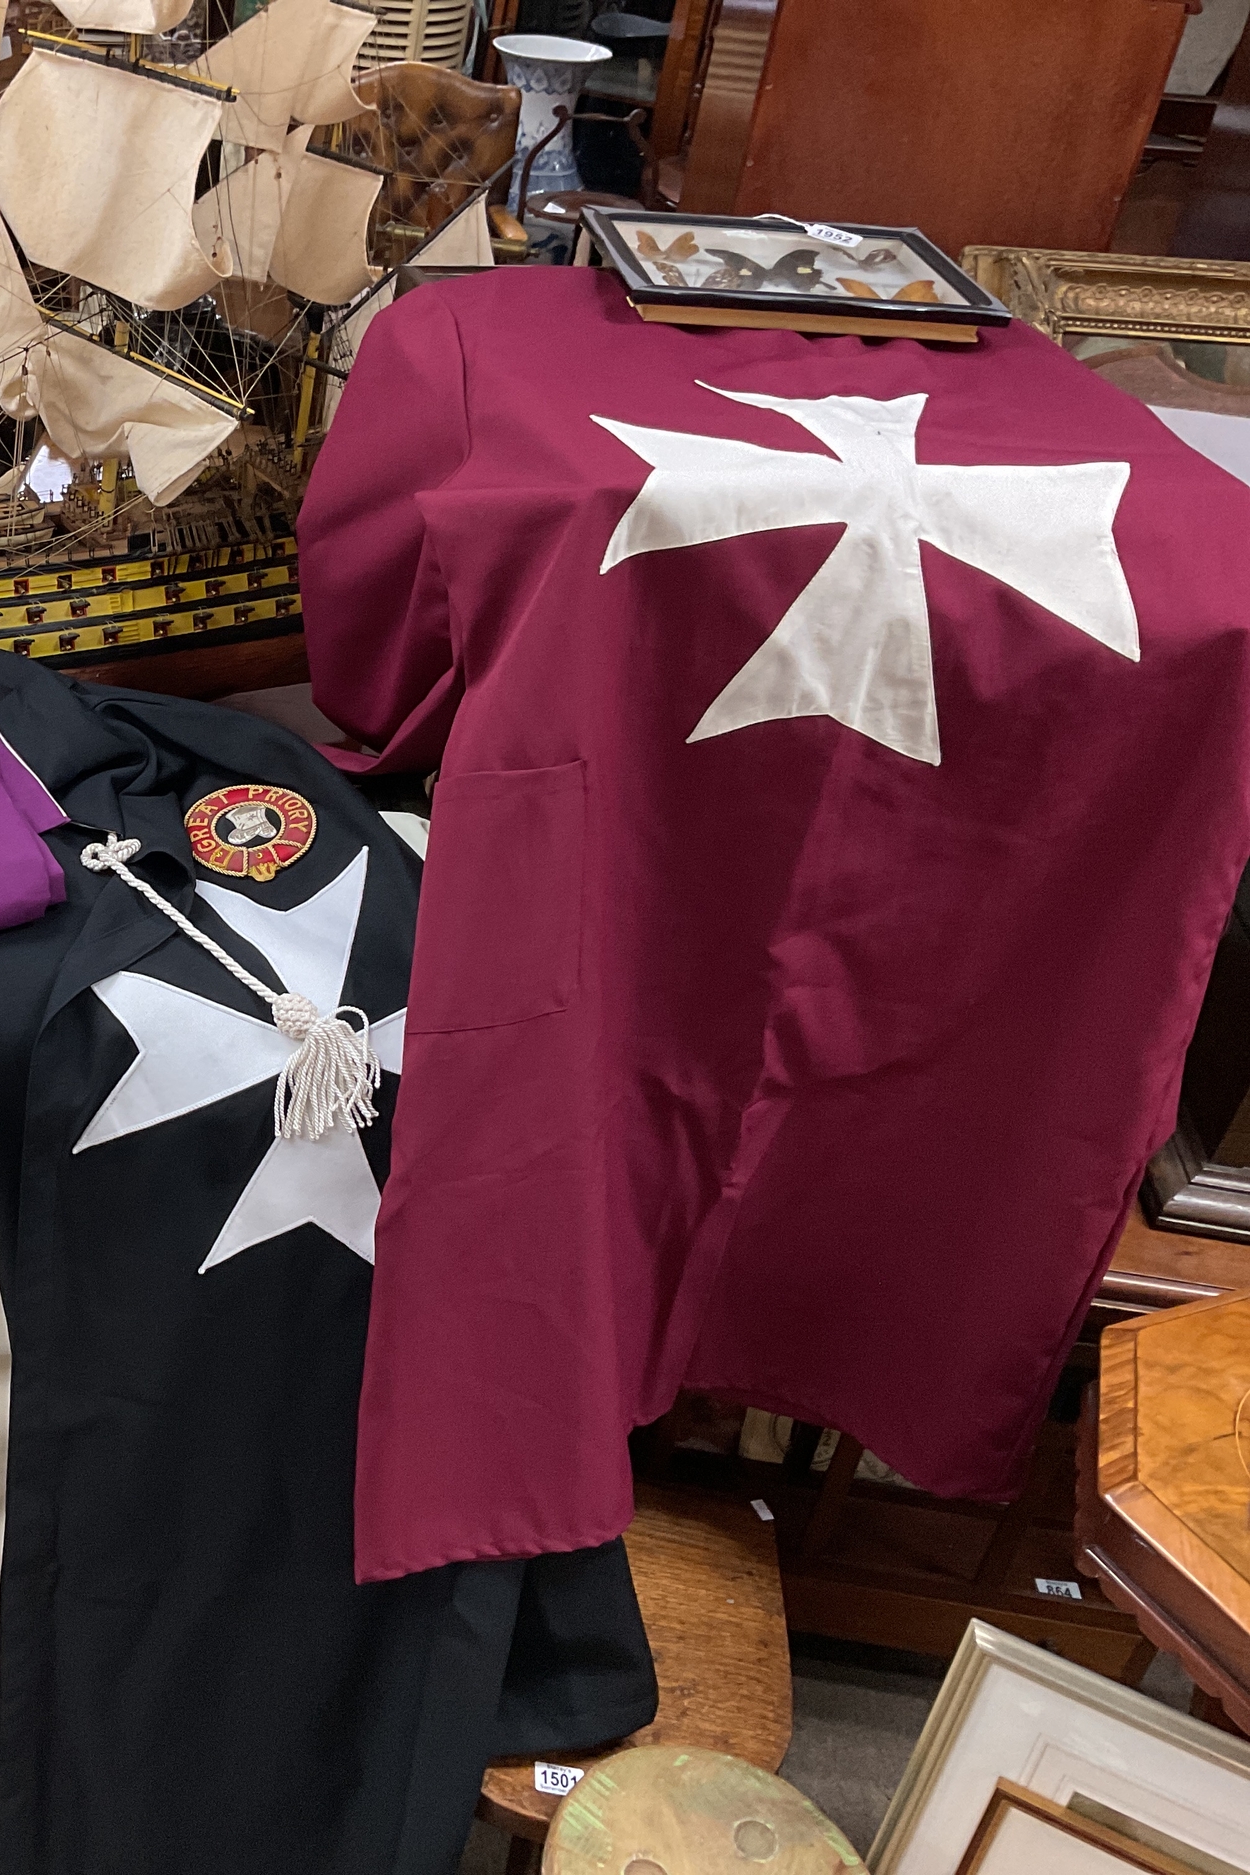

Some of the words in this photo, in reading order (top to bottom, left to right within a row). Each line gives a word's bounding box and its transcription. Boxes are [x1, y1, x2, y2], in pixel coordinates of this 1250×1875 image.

[816, 228, 853, 242] 1952
[187, 791, 230, 853] GREAT
[248, 786, 311, 834] PRIORY
[540, 1769, 578, 1788] 1501
